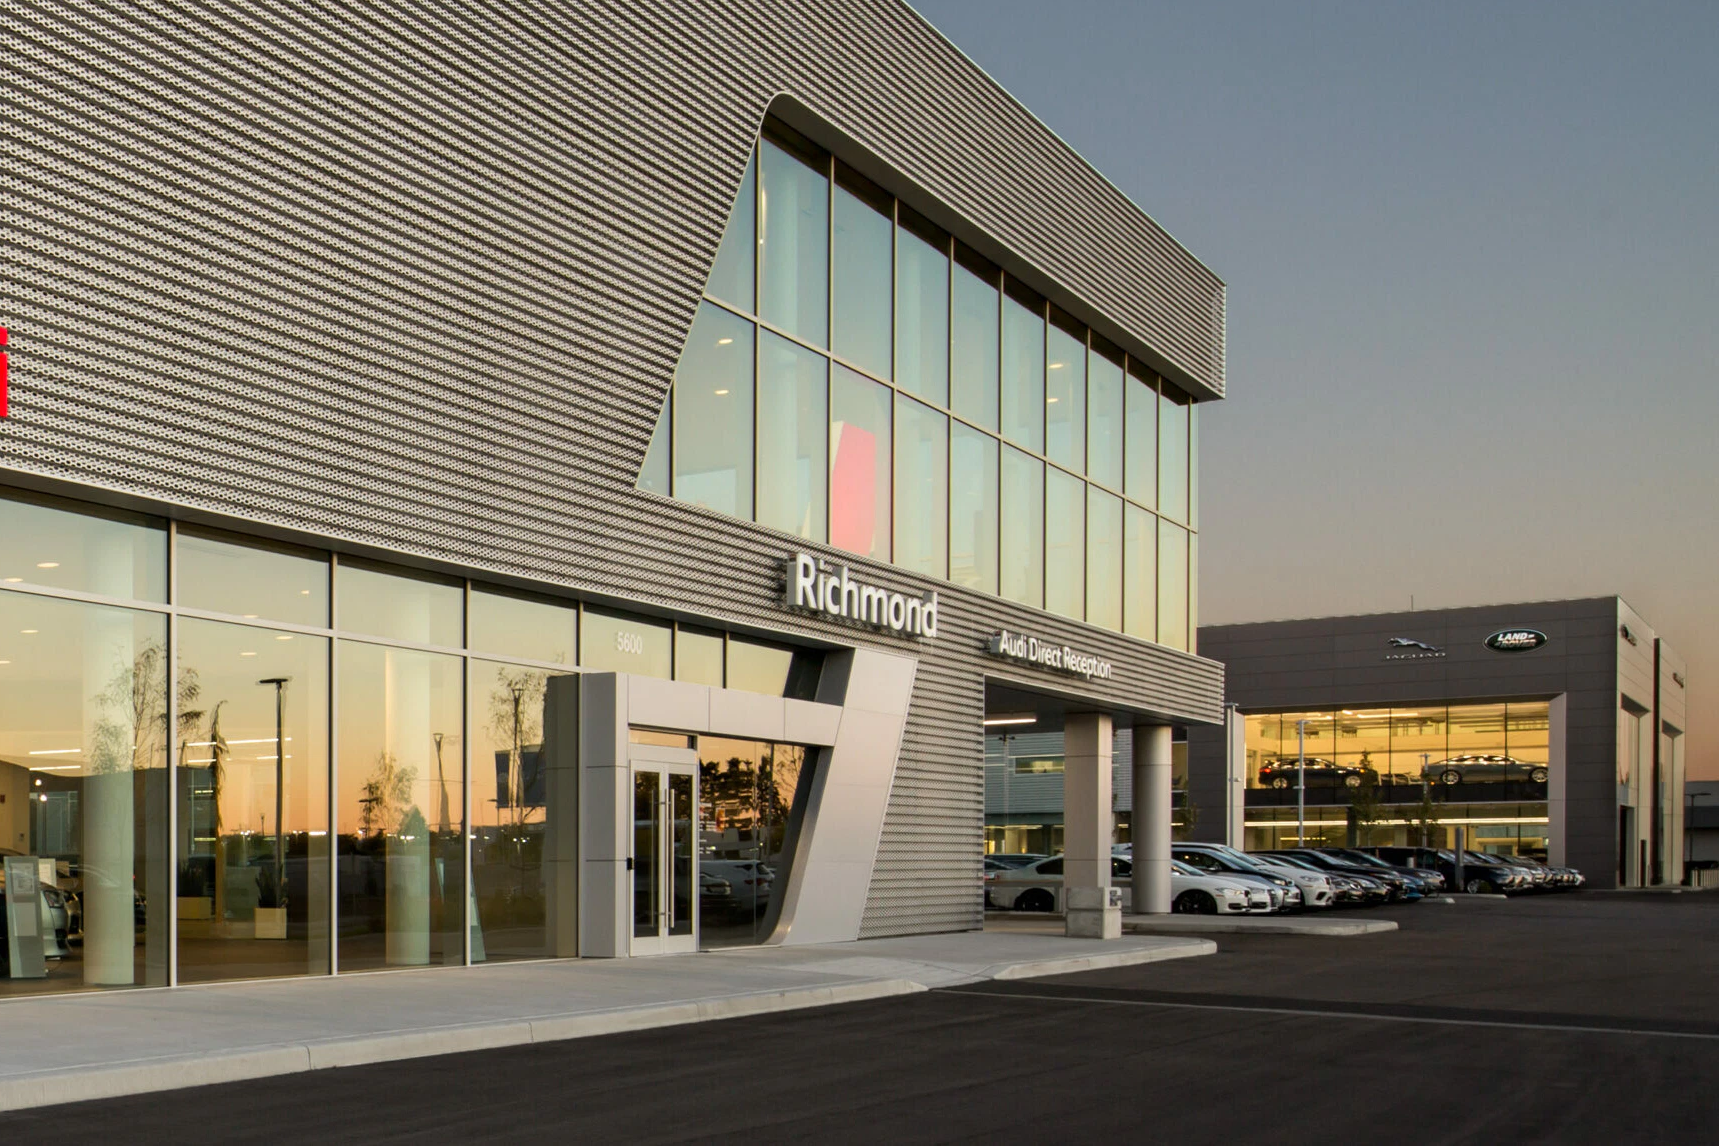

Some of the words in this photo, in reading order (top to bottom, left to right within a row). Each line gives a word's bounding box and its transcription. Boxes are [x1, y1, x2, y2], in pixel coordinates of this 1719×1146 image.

[792, 553, 938, 638] Richmond
[616, 631, 643, 655] 5600
[999, 629, 1027, 658] Audi
[1028, 637, 1062, 668] Direct
[1063, 646, 1112, 680] Reception
